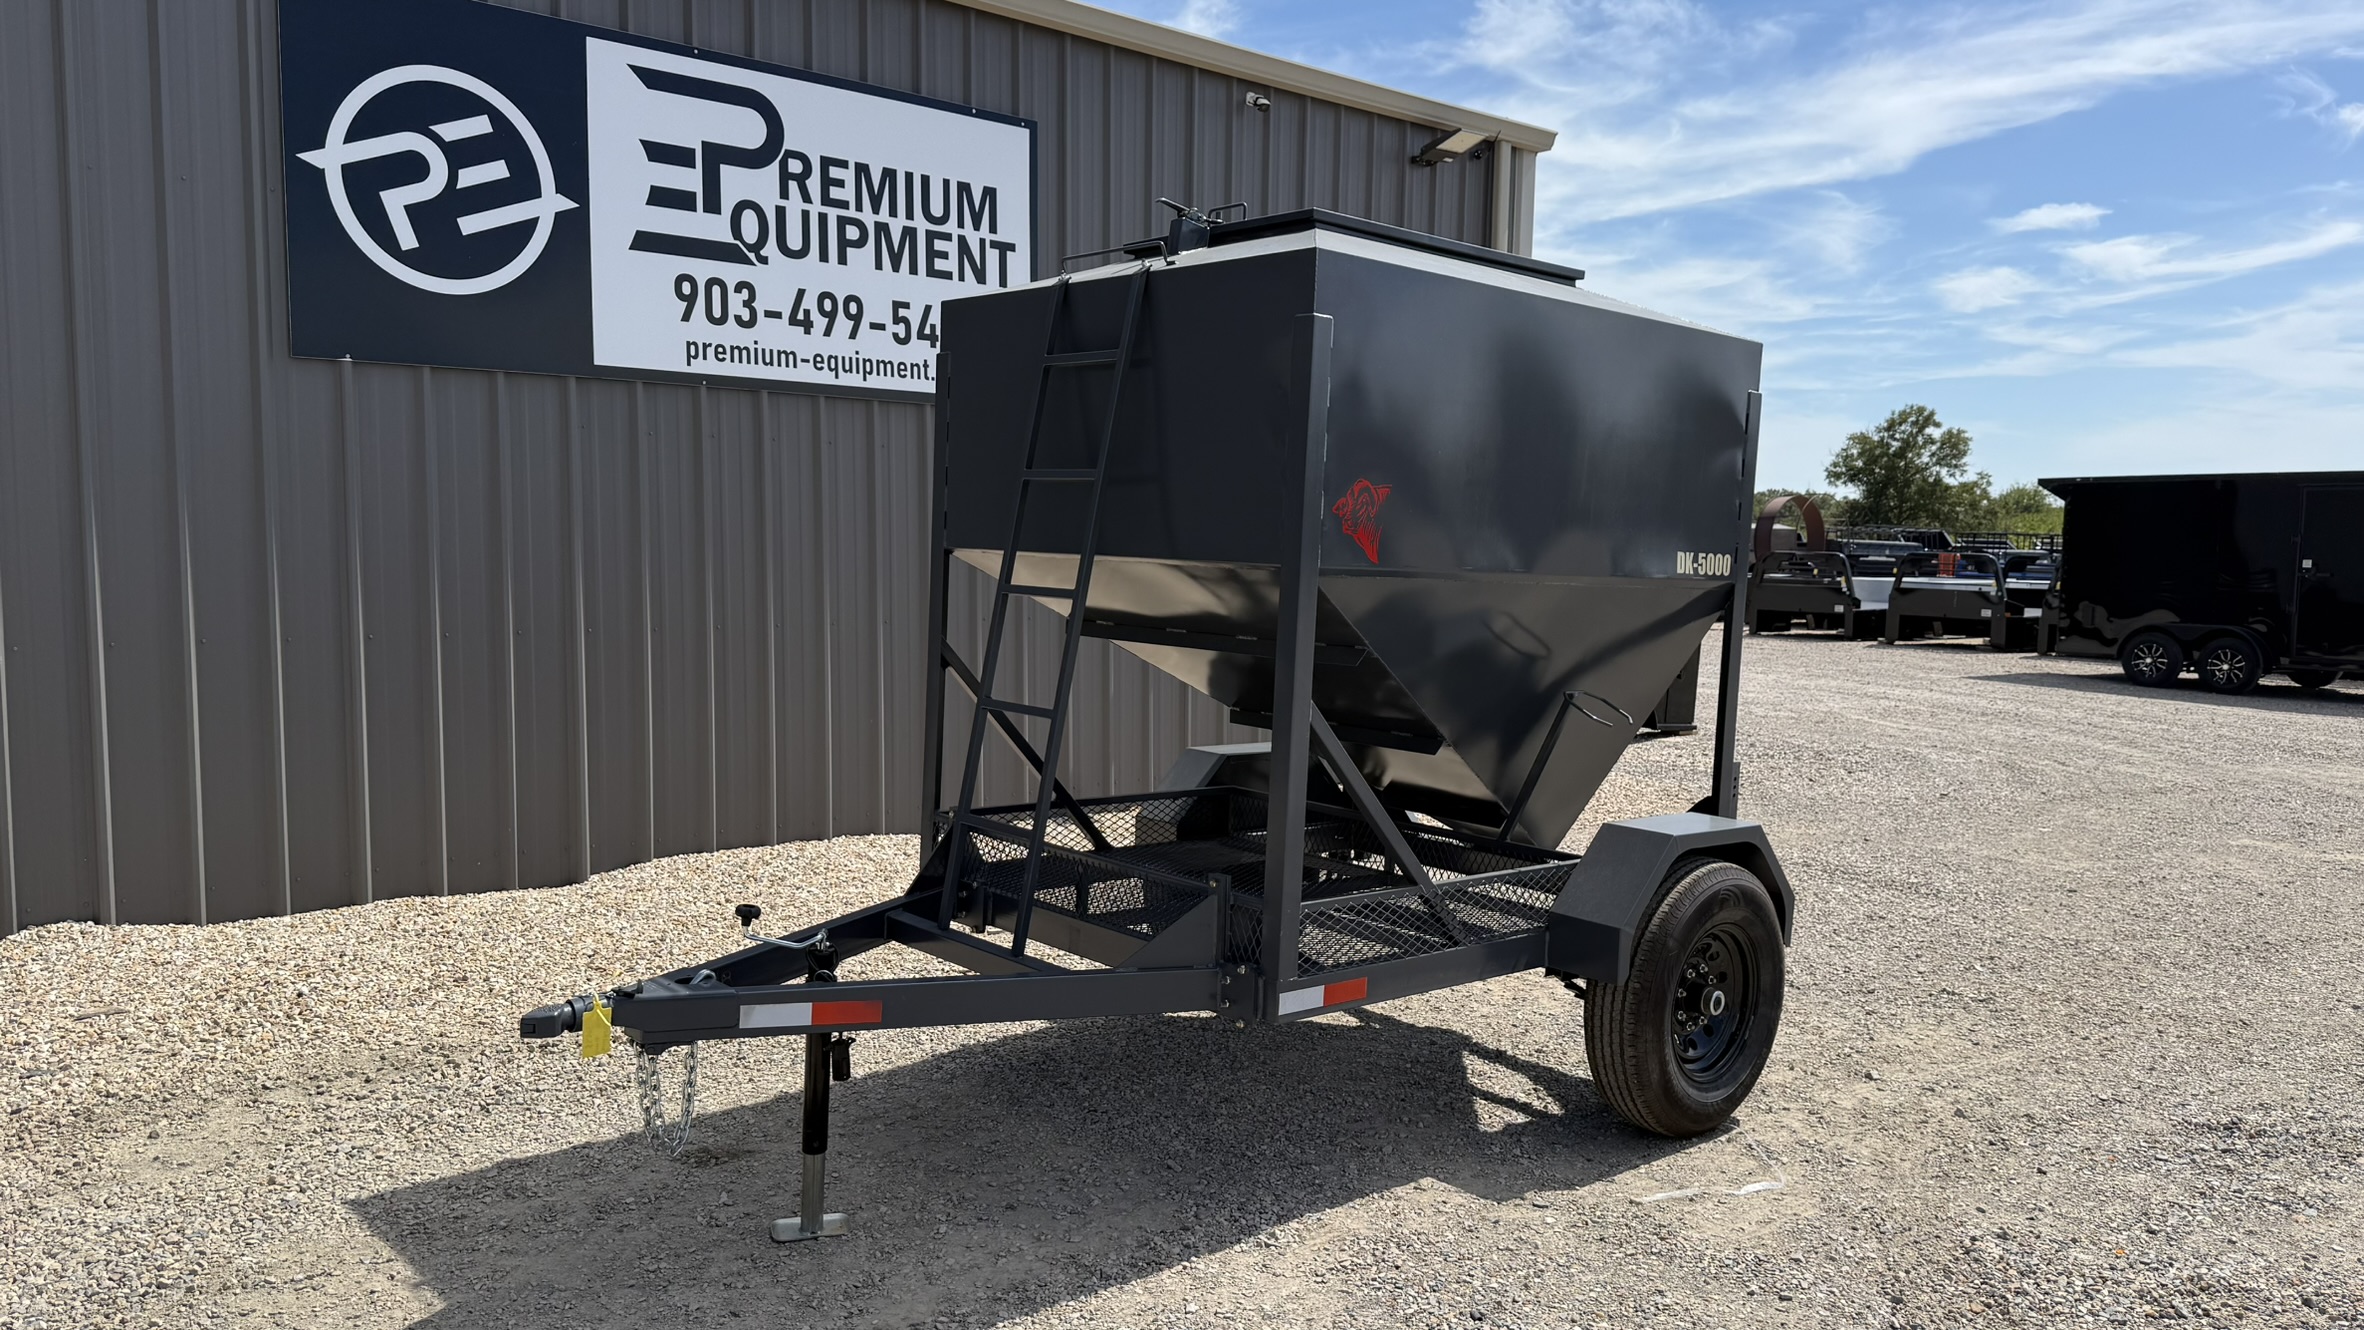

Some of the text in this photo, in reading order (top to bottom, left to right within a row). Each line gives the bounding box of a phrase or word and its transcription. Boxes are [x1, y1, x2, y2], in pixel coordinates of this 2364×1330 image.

[626, 63, 998, 236] PREMIUM
[674, 273, 939, 349] 903-499-54
[1676, 551, 1732, 577] DK-5000
